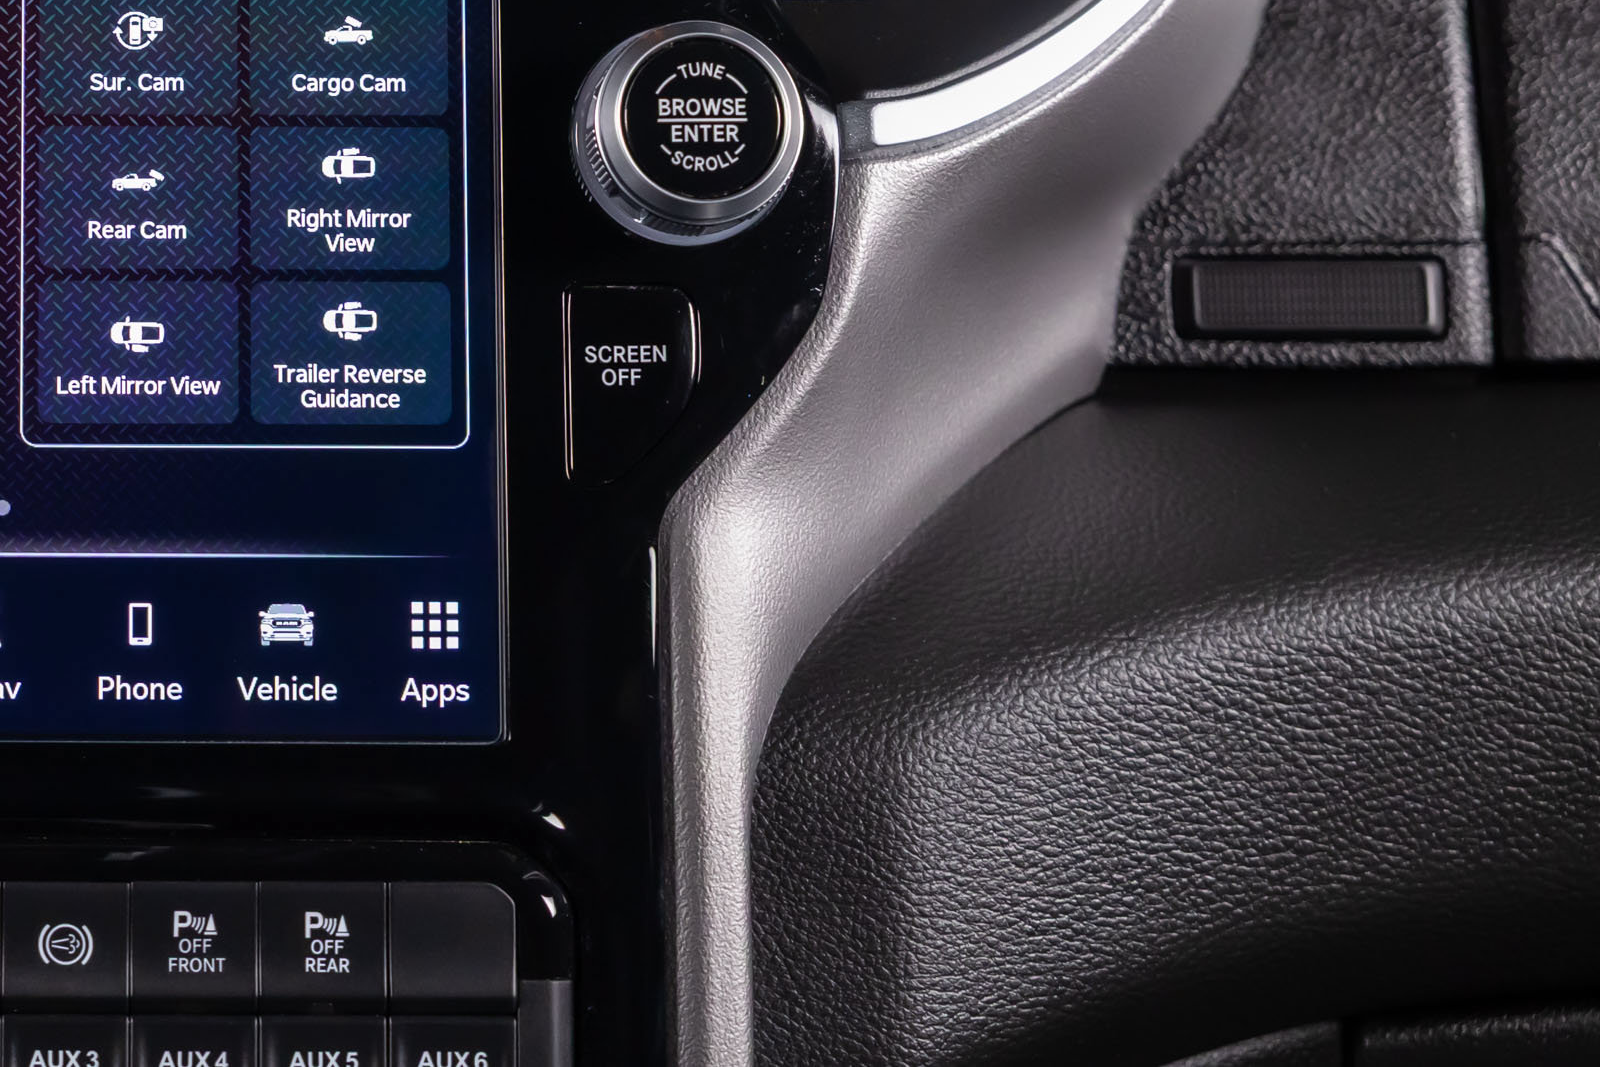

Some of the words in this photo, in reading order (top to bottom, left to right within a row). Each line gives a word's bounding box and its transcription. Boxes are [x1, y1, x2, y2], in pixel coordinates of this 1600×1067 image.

[676, 61, 726, 80] TUNE
[89, 72, 132, 92] Sur.
[137, 73, 185, 92] Cam
[291, 73, 355, 97] Cargo
[359, 73, 407, 93] Cam
[658, 97, 747, 117] BROWSE
[671, 124, 740, 143] ENTER
[671, 150, 740, 173] SCROLL
[87, 220, 136, 240] Rear
[139, 220, 187, 240] Cam
[287, 207, 343, 233] Right
[346, 207, 412, 228] Mirror
[324, 232, 376, 253] View
[584, 344, 667, 364] SCREEN
[272, 363, 340, 384] Trailer
[343, 364, 427, 384] Reverse
[601, 368, 642, 386] OFF
[56, 374, 98, 395] Left
[101, 374, 167, 395] Mirror
[170, 375, 221, 396] View
[300, 388, 401, 409] Guidance
[98, 674, 183, 701] Phone
[236, 675, 338, 702] Vehicle
[400, 677, 470, 708] Apps
[173, 910, 193, 938] P
[304, 911, 324, 939] P
[178, 938, 212, 954] OFF
[310, 939, 345, 955] OFF
[168, 957, 226, 973] FRONT
[305, 957, 350, 974] REAR
[28, 1049, 81, 1067] AUX
[85, 1050, 100, 1067] 3
[158, 1050, 211, 1067] AUX
[214, 1051, 229, 1067] 4
[289, 1051, 341, 1067] AUX
[345, 1051, 359, 1067] 5
[417, 1050, 470, 1067] AUX
[473, 1051, 489, 1067] 6
